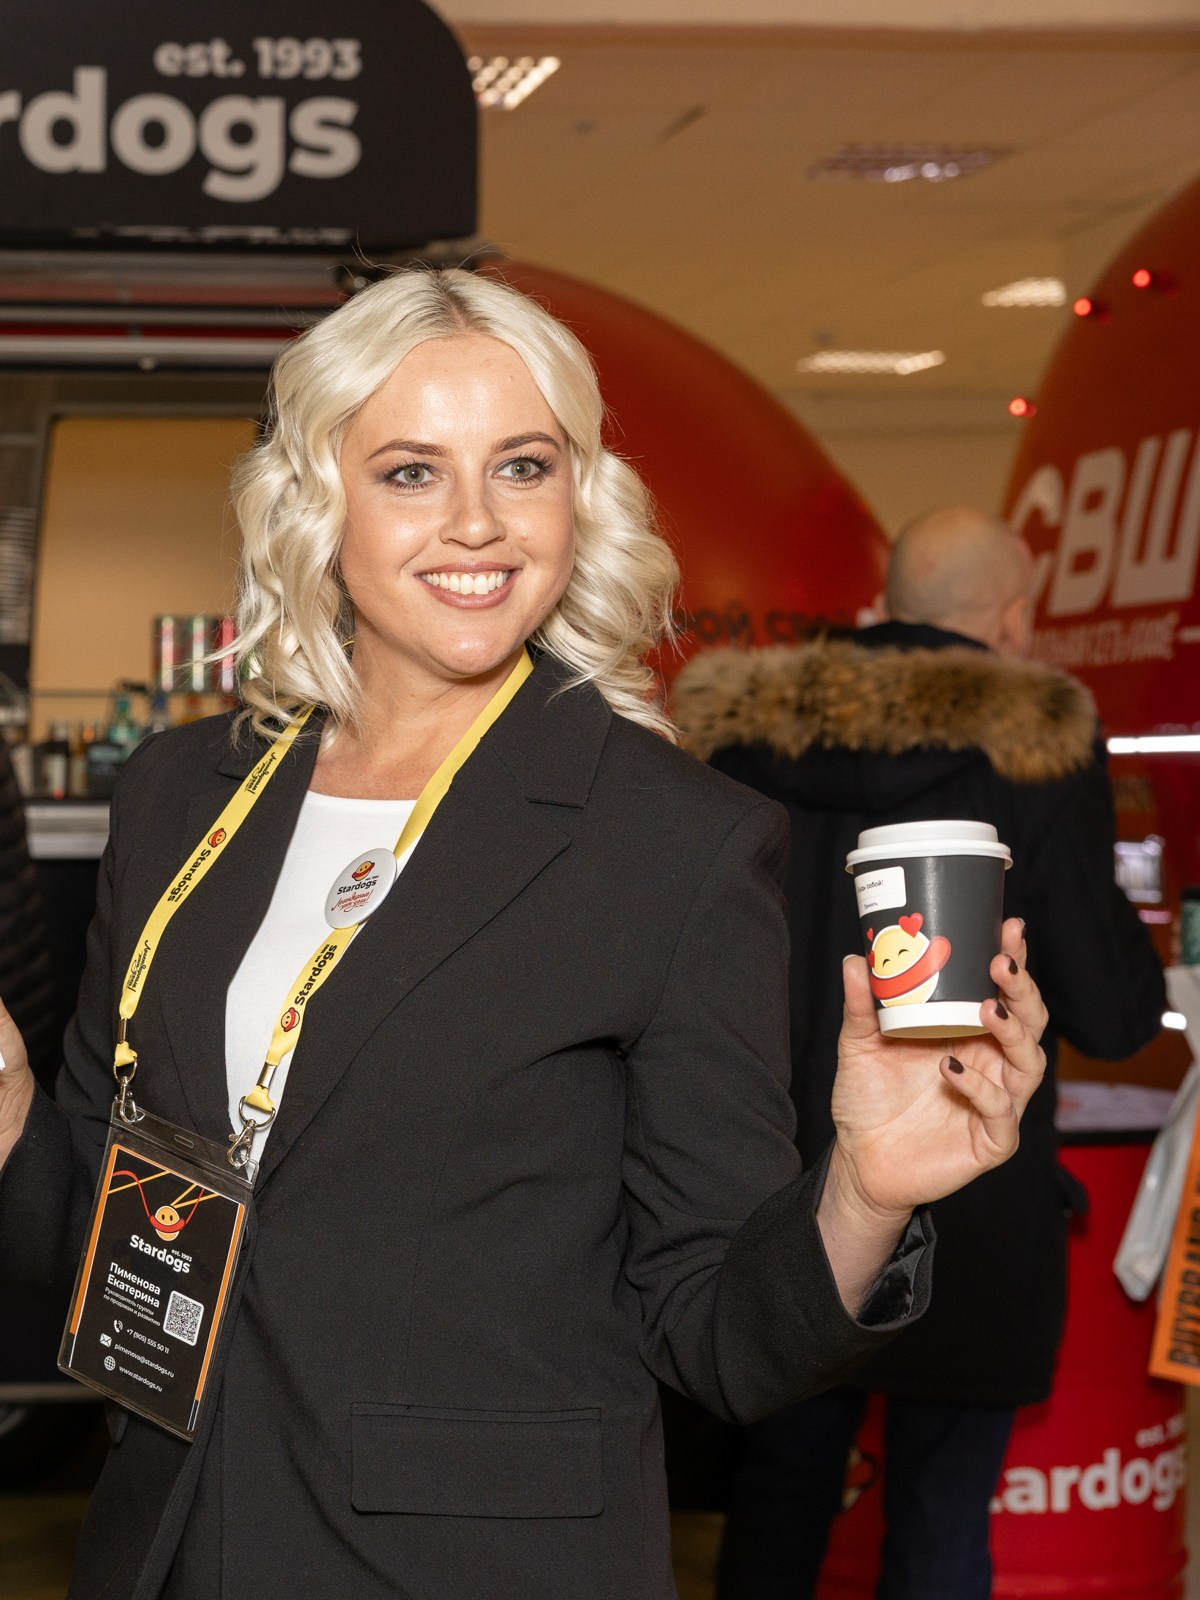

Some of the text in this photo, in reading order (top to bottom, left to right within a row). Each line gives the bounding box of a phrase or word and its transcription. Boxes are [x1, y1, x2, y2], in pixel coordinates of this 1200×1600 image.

[153, 37, 361, 79] est. 1993
[167, 849, 211, 901] Stardogs
[337, 879, 377, 895] Stardogs
[294, 945, 337, 1006] Stardogs
[129, 1234, 191, 1273] Stardogs
[107, 1273, 160, 1308] Екатерина
[110, 1262, 161, 1295] Пименова
[114, 1344, 175, 1378] pimenova@stardogs.ru
[118, 1366, 163, 1392] www.stardogs.ru
